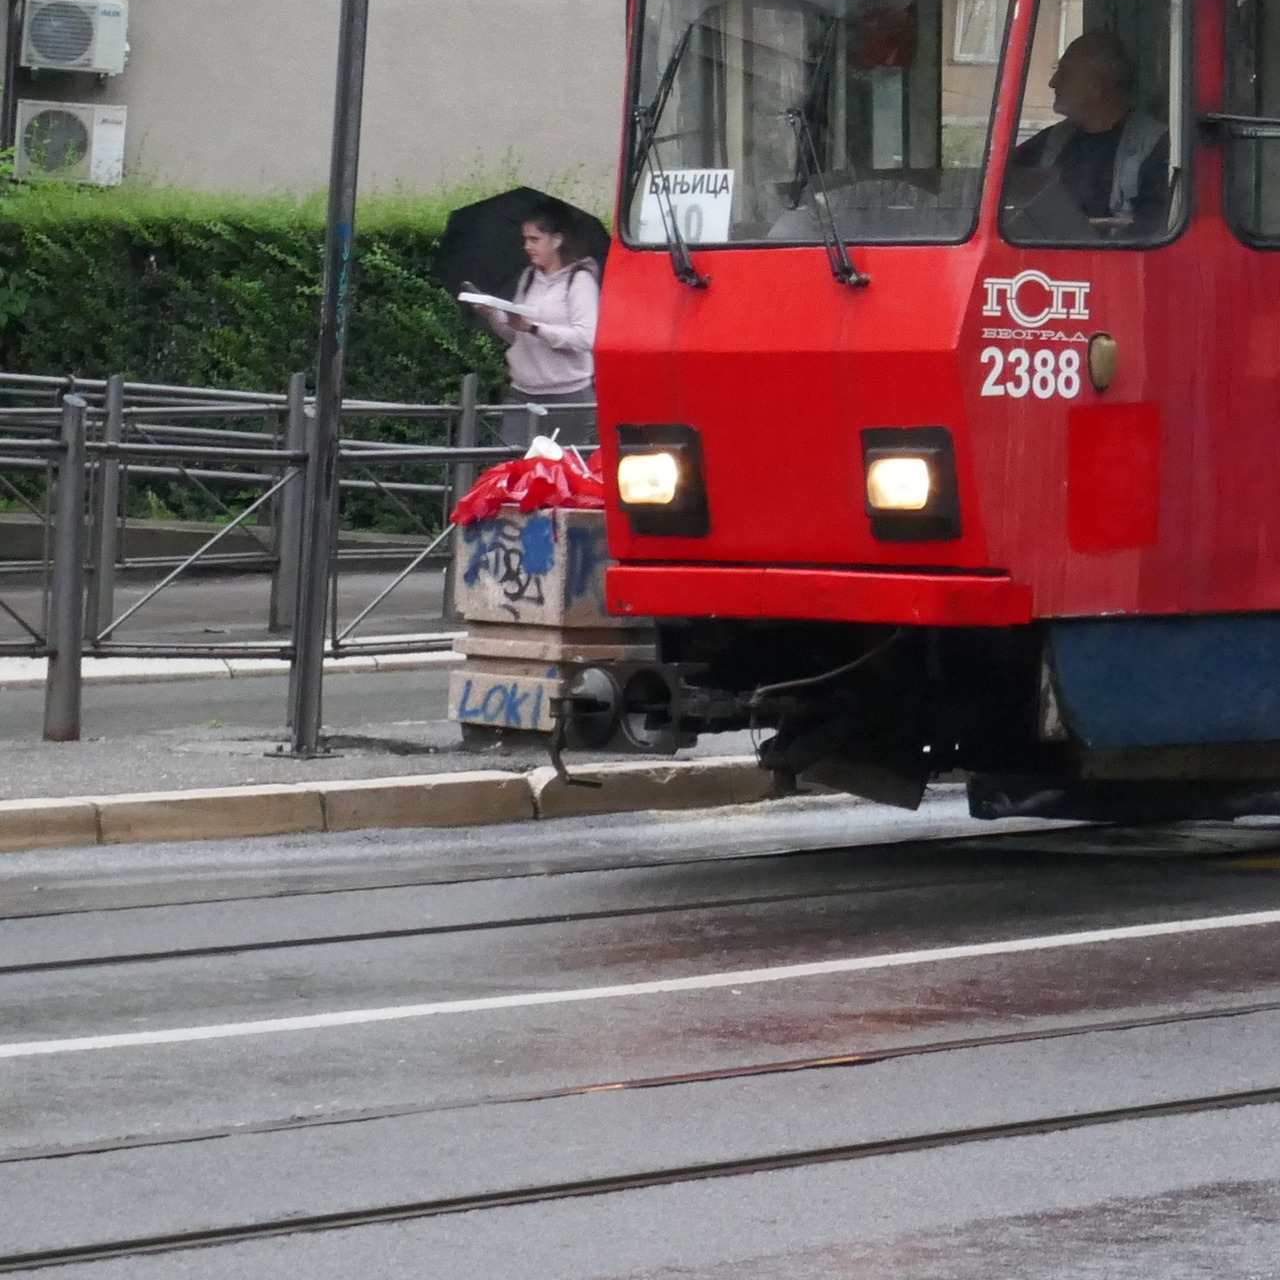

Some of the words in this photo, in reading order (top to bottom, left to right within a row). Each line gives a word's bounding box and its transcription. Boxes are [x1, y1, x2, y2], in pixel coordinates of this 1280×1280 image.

[648, 173, 730, 198] БАЊИЦА
[982, 328, 1088, 343] БЕОГРАД
[980, 346, 1081, 399] 2388
[457, 678, 545, 727] LOKI
